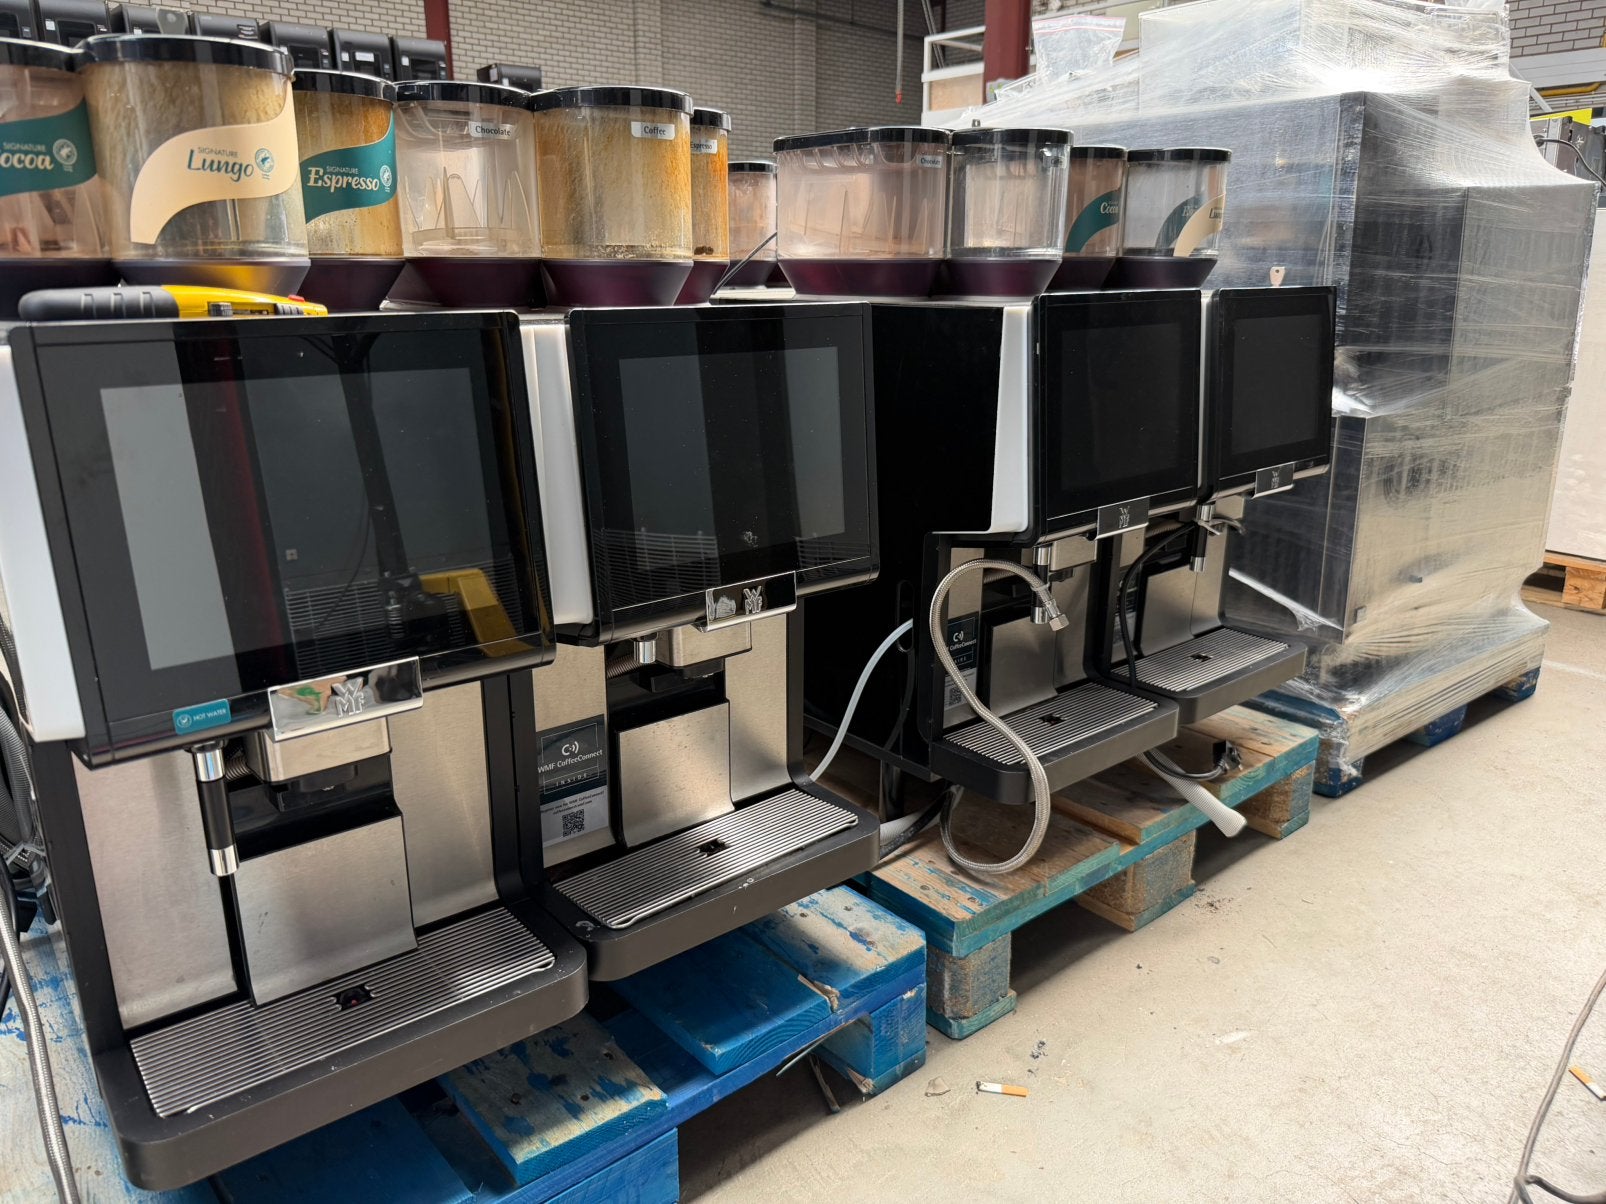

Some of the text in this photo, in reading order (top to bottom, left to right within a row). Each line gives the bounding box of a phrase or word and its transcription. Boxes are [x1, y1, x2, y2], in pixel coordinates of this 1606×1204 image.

[475, 125, 511, 136] Chocolate
[643, 126, 666, 135] Coffee
[3, 142, 47, 152] SIGNATURE
[198, 147, 238, 158] SIGNATURE
[0, 152, 54, 170] ocoa
[187, 149, 254, 182] Lungo
[326, 166, 359, 175] SIGNATURE
[306, 167, 380, 193] Espresso
[193, 708, 227, 722] HOT WATER
[537, 749, 603, 774] WMF CoffeeConnect
[556, 772, 588, 787] INSIDE
